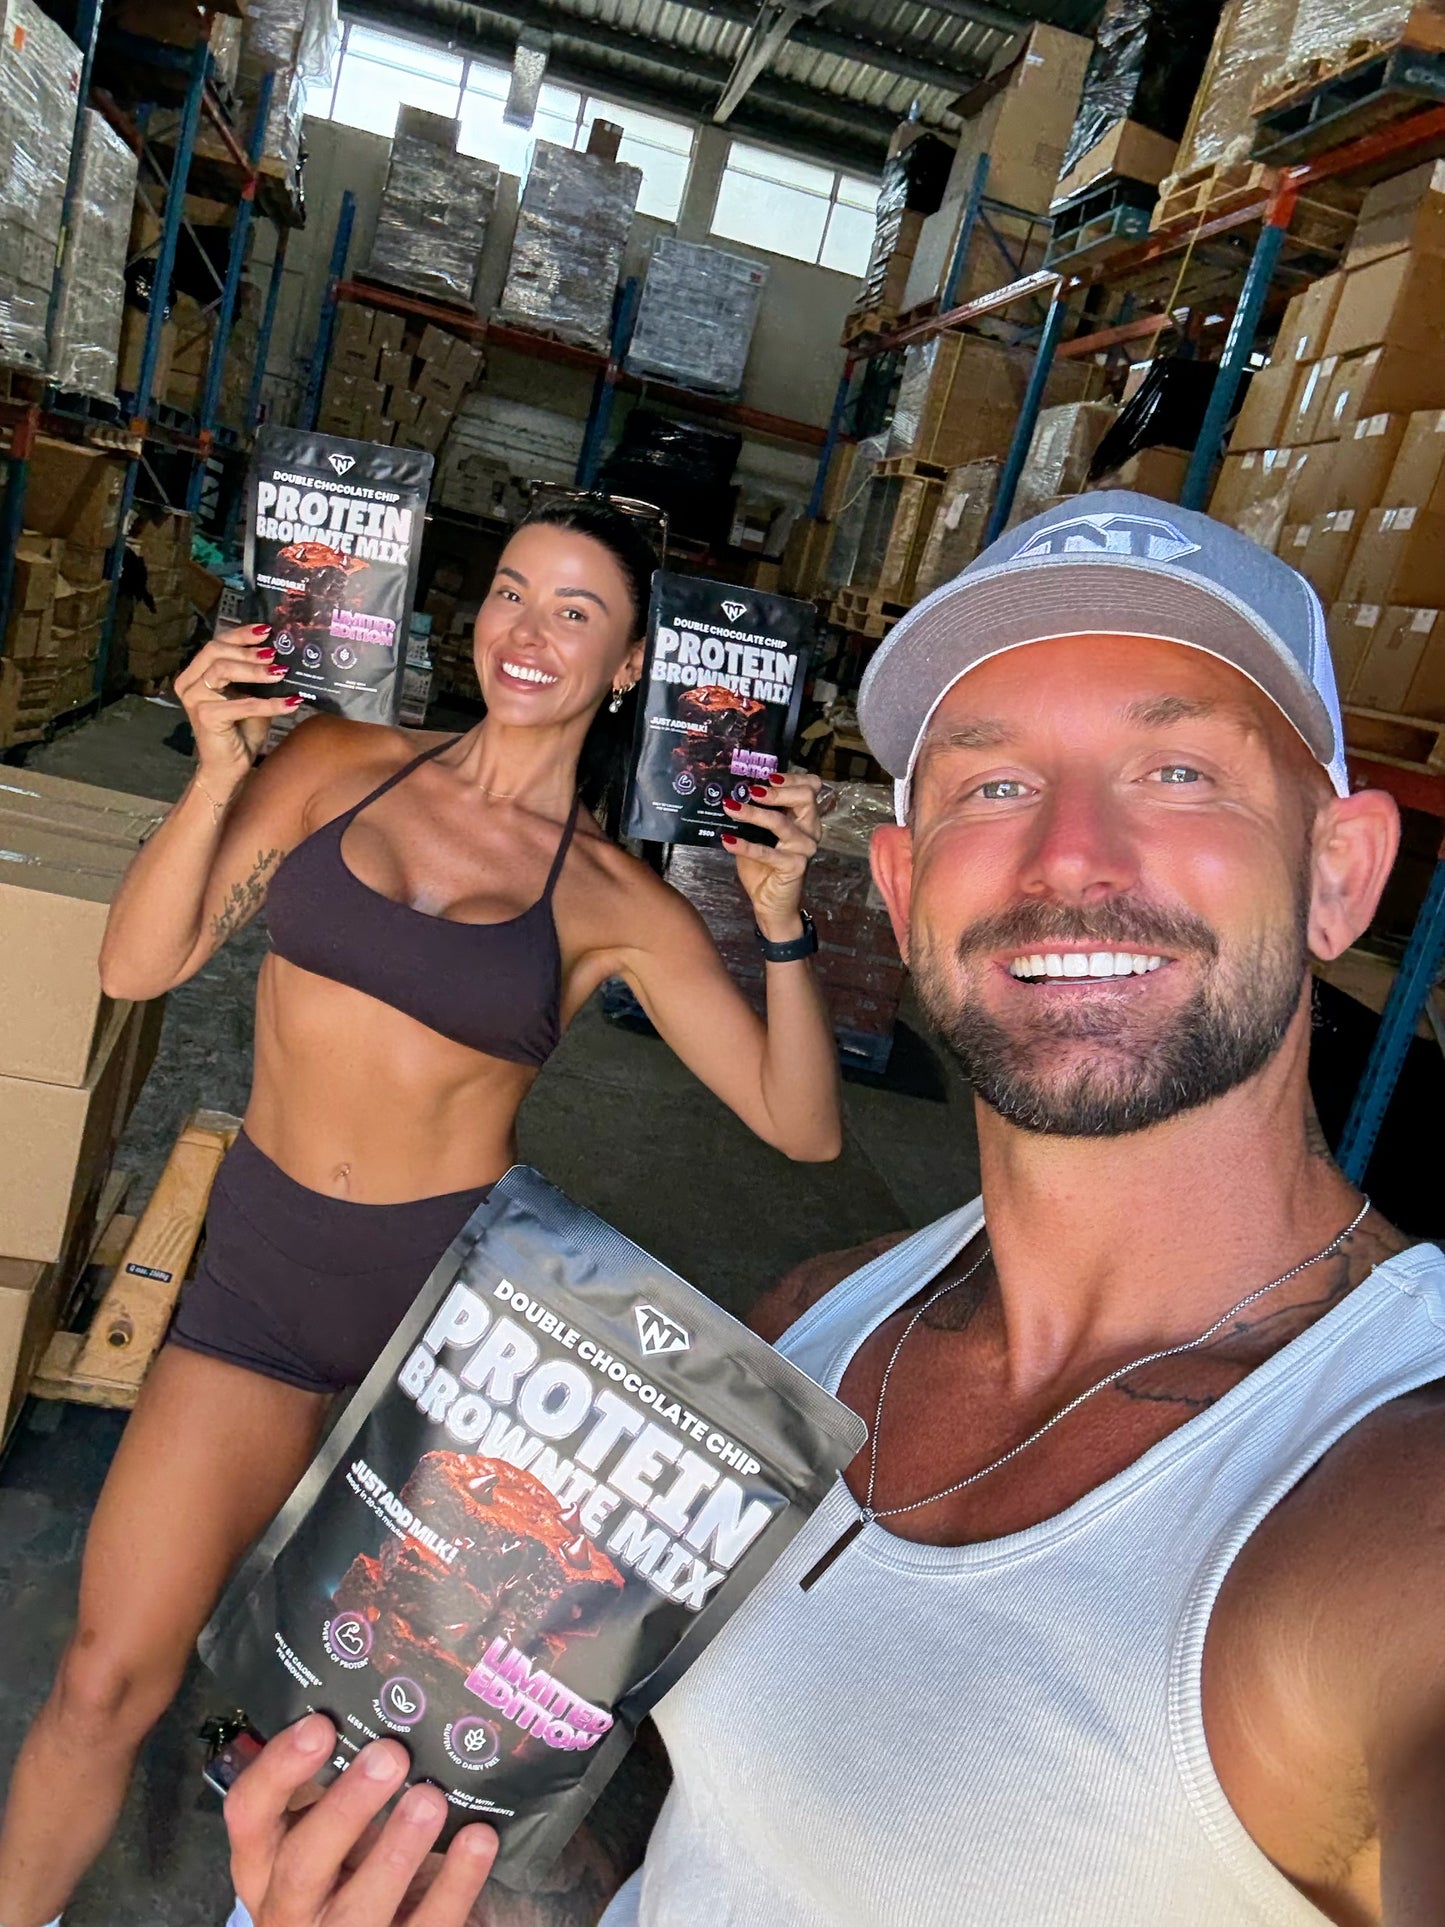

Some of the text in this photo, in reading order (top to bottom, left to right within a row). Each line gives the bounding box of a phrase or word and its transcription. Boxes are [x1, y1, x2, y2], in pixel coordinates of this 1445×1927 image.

[273, 470, 400, 503] DOUBLE CHOCOLATE CHIP
[257, 481, 412, 543] PROTEIN
[256, 514, 410, 566] BROWNIE MIX
[654, 627, 798, 685] PROTEIN
[673, 617, 788, 649] DOUBLE CHOCOLATE CHIP
[651, 659, 792, 706] BROWNIE MIX
[650, 716, 671, 726] JUST
[670, 719, 687, 729] ADD
[493, 1279, 761, 1477] DOUBLE CHOCOLATE CHIP
[423, 1281, 774, 1571] PROTEIN
[360, 1490, 367, 1500] in
[398, 1342, 729, 1612] BROWNIE MIX
[351, 1459, 459, 1564] JUST ADD MILK!
[274, 1632, 288, 1650] ONLY
[322, 1620, 331, 1641] OVER
[330, 1653, 340, 1662] OF
[276, 1646, 310, 1688] PER BROWNIE
[481, 1635, 614, 1734] LIMITED
[347, 1714, 363, 1730] LESS
[372, 1699, 411, 1733] PLANT-BASED
[464, 1662, 603, 1751] EDITION
[443, 1723, 500, 1771] GLUTEN AND DAIRY FREE
[452, 1789, 495, 1807] MADE WITH
